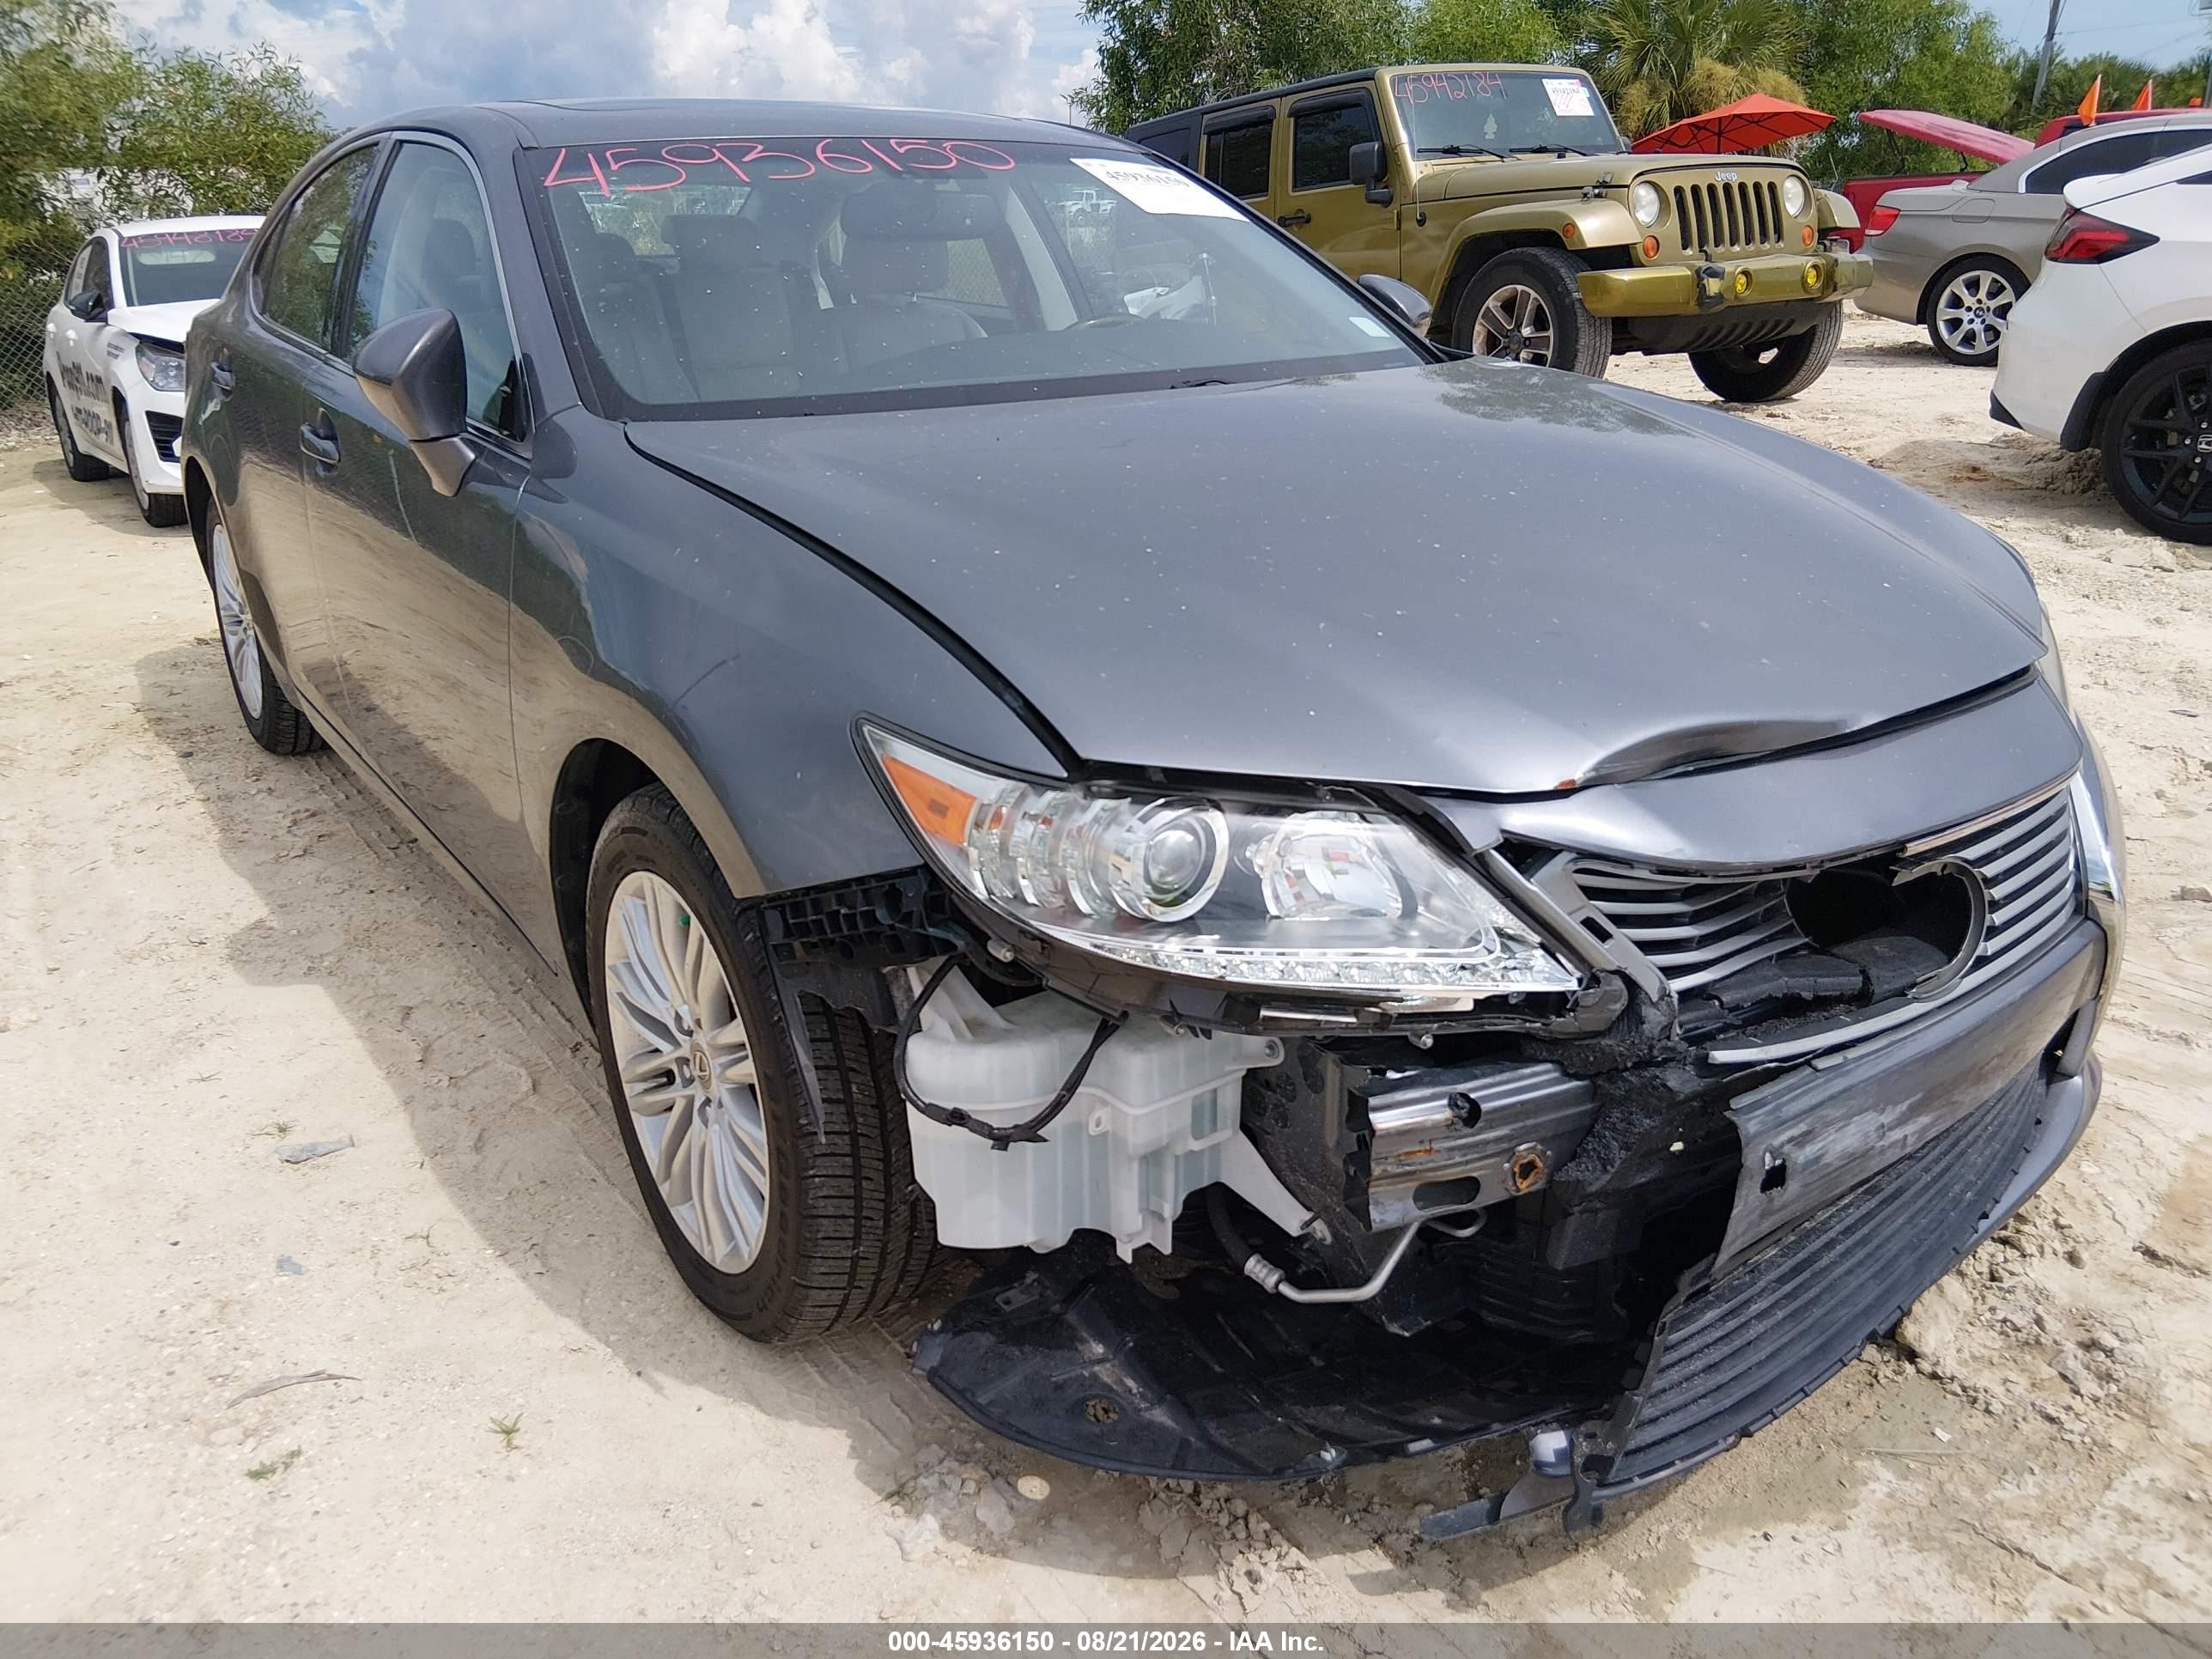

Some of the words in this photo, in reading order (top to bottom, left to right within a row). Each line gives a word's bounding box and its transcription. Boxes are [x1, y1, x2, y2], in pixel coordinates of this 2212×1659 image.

[1395, 71, 1508, 105] 45942184
[544, 137, 1017, 198] 45936150
[1715, 171, 1738, 182] Jeep
